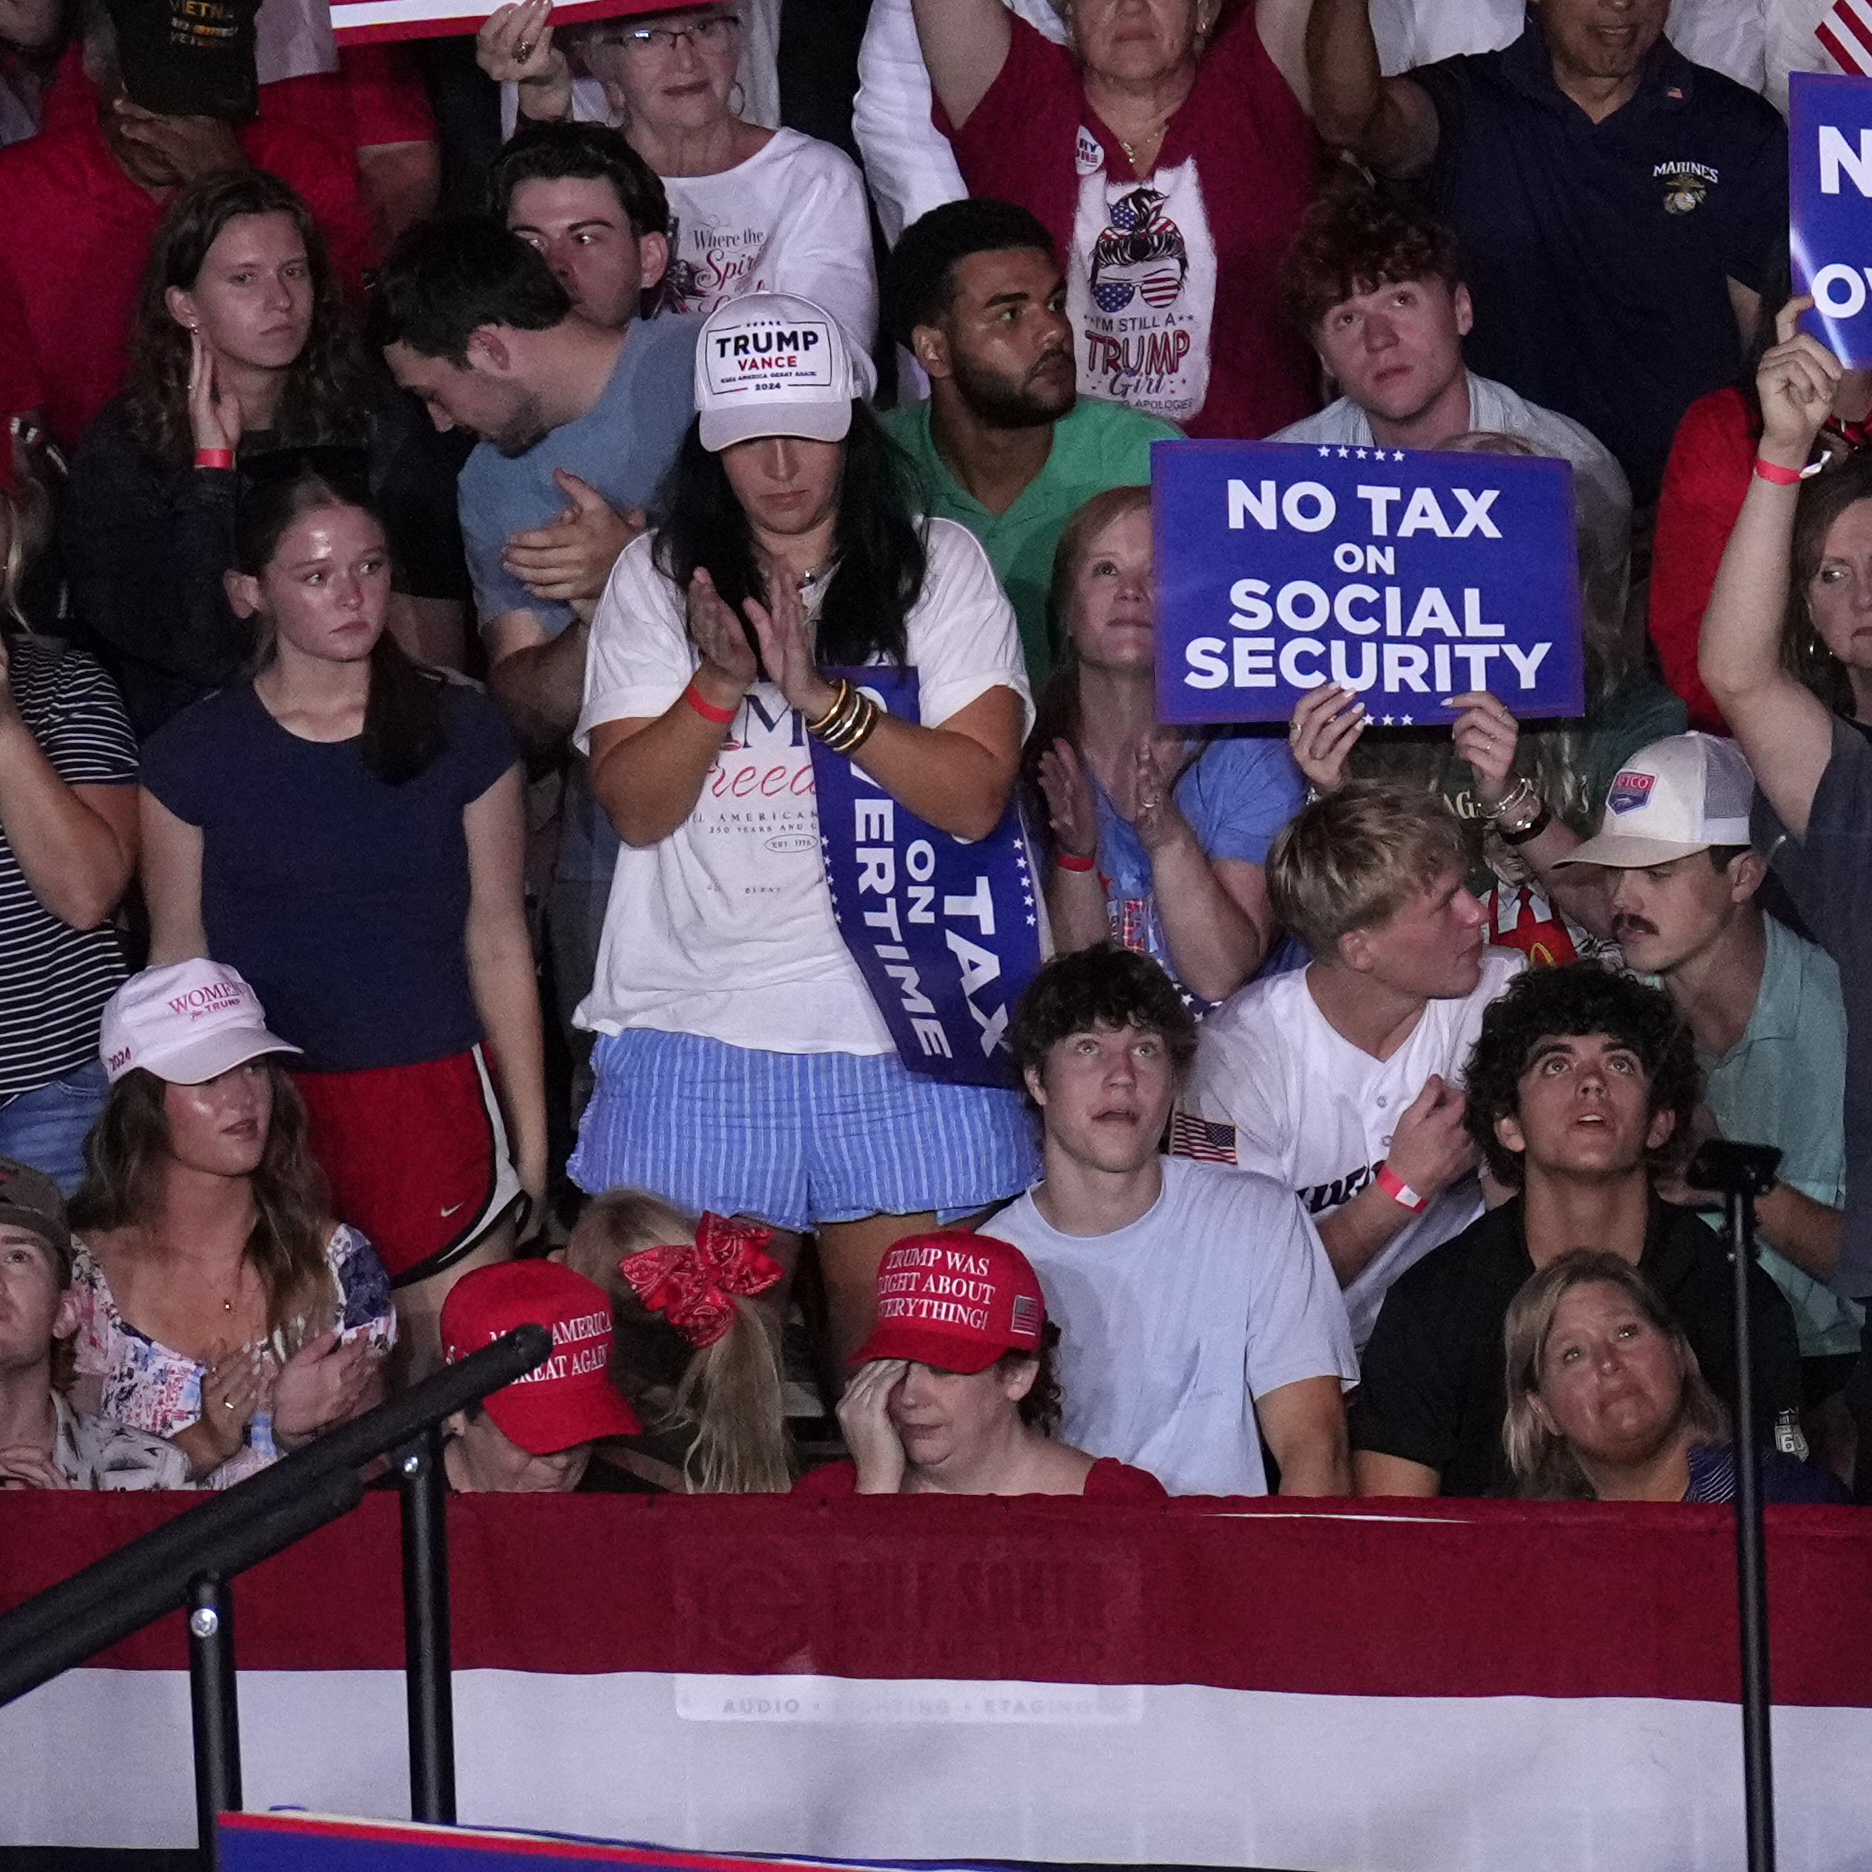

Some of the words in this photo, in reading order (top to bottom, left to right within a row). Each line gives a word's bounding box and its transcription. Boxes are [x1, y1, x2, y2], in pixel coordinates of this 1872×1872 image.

[1653, 160, 1719, 185] MARINES
[691, 227, 741, 250] Where
[743, 227, 764, 246] the
[1119, 316, 1161, 334] STILL
[1164, 313, 1177, 329] A
[715, 329, 818, 358] TRUMP
[1084, 329, 1191, 376] TRUMP
[738, 355, 798, 372] VANCE
[755, 381, 782, 392] 2024
[1108, 368, 1166, 398] Girl
[1226, 479, 1337, 532] NO
[1357, 485, 1503, 540] TAX
[1333, 541, 1396, 576] ON
[1227, 578, 1506, 639] SOCIAL
[1183, 636, 1554, 694] SECURITY
[905, 840, 936, 925] ON
[943, 875, 1011, 1059] TAX
[169, 980, 248, 1015] WOMEN
[109, 1045, 131, 1072] 2024
[884, 1247, 943, 1269] TRUMP
[945, 1250, 991, 1277] WAS
[921, 1273, 996, 1305] ABOUT
[722, 1697, 801, 1716] AUDIO
